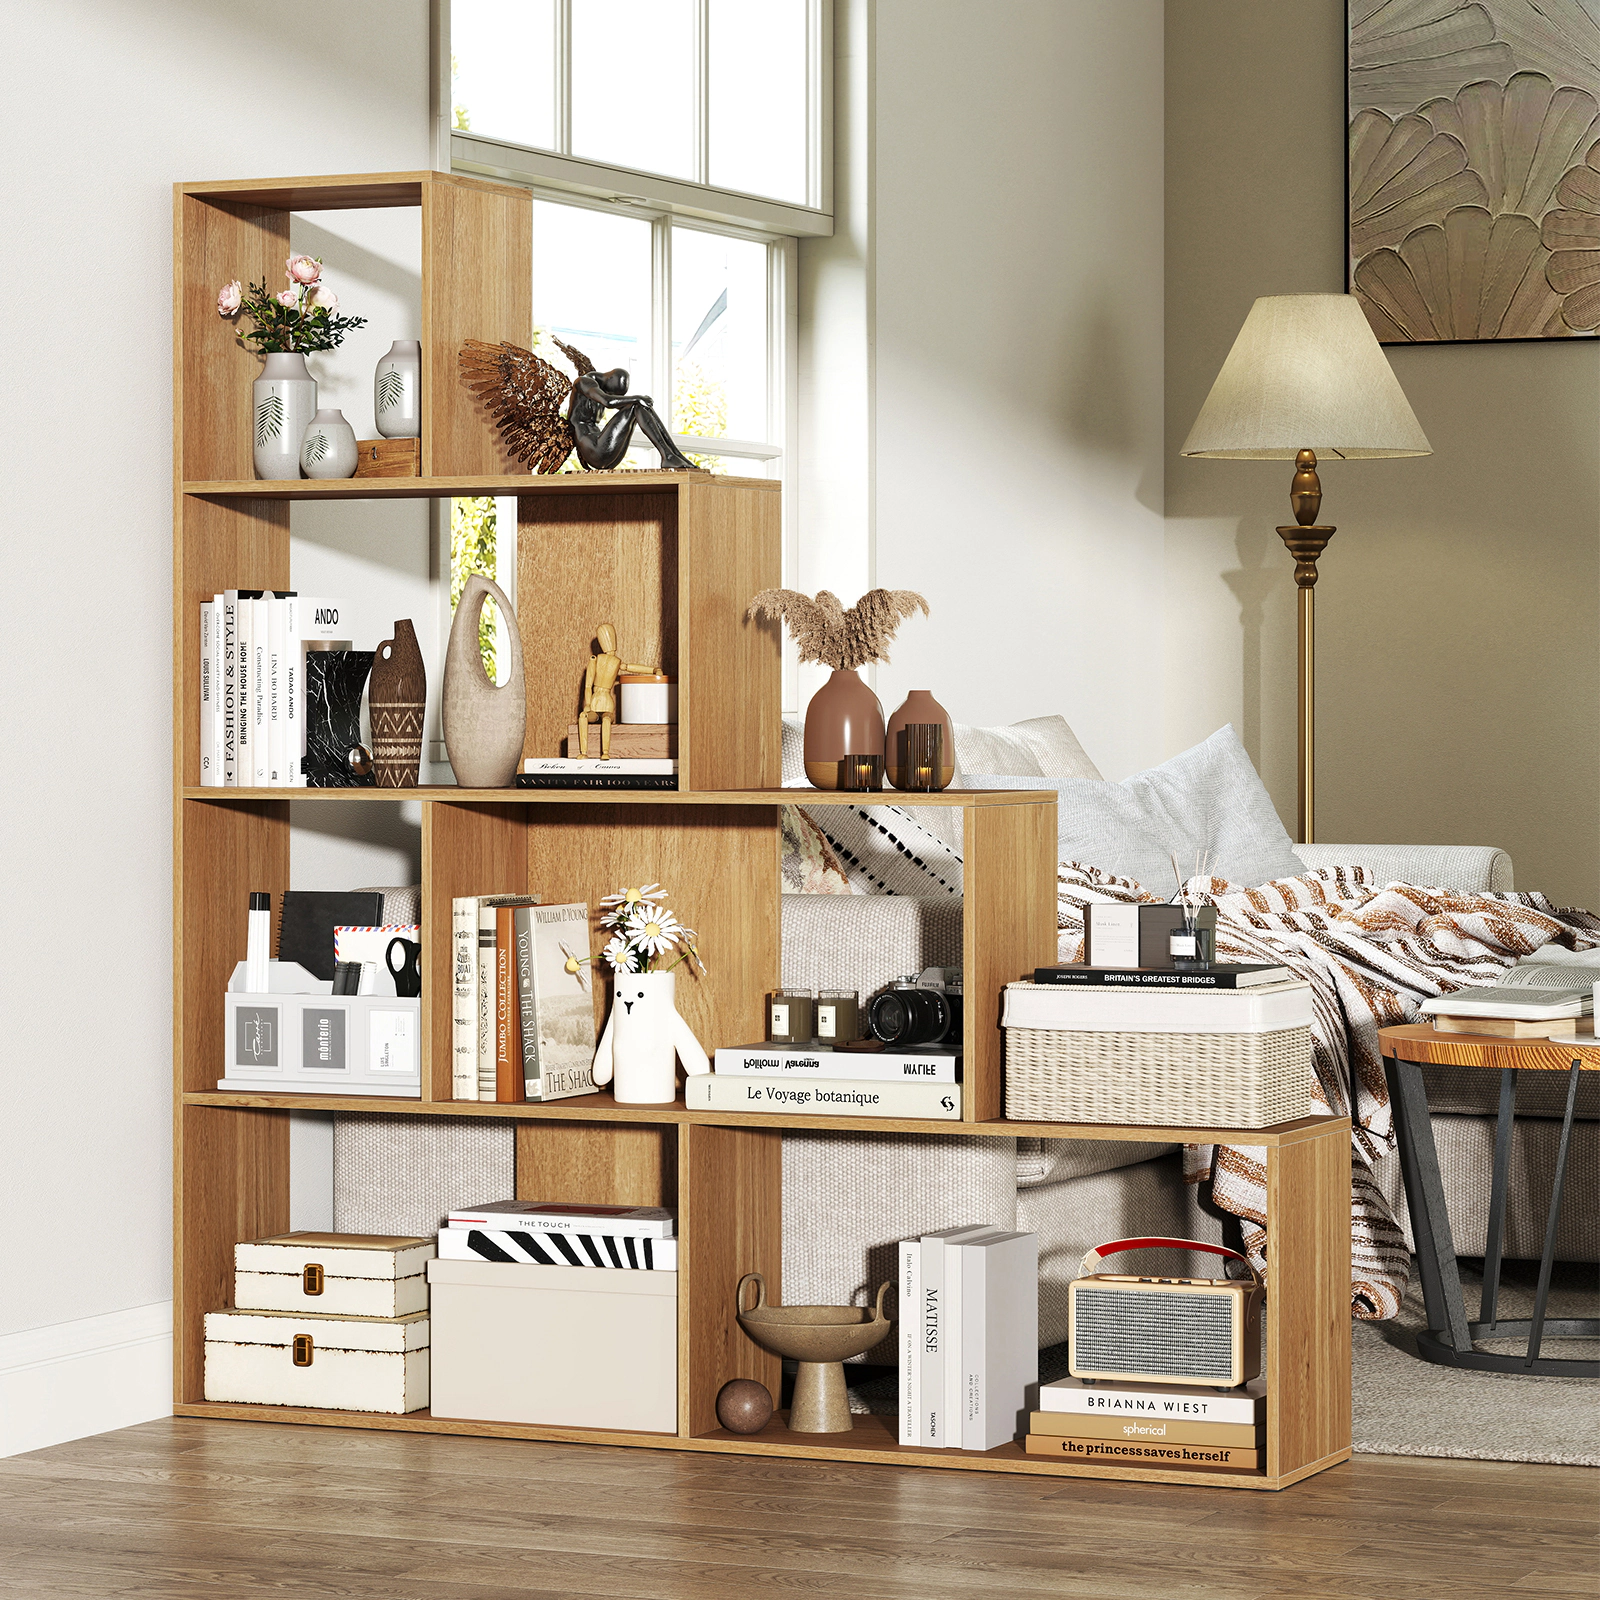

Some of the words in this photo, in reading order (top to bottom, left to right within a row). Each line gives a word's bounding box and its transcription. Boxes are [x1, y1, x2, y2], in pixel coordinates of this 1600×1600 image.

[314, 608, 339, 625] ANDO
[225, 605, 235, 660] STYLE
[225, 665, 235, 678] &
[271, 677, 277, 690] BO
[225, 682, 235, 762] FASHION
[520, 777, 570, 786] VANITY
[573, 778, 603, 786] FAIR
[635, 779, 676, 787] YEARS
[535, 910, 562, 924] WILLIAM
[567, 907, 588, 922] YOUNG
[517, 930, 530, 980] YOUNG
[498, 948, 507, 1021] COLLECTION
[1103, 974, 1141, 983] BRITAIN'S
[1142, 975, 1181, 984] GREATEST
[1181, 976, 1216, 984] BRIDGES
[521, 990, 534, 1016] THE
[498, 1024, 509, 1063] JUMBO
[522, 1020, 536, 1064] SHACK
[546, 1072, 566, 1093] THE
[568, 1069, 593, 1090] SHAC
[747, 1086, 762, 1100] Le
[765, 1087, 812, 1105] Voyage
[815, 1088, 880, 1107] botanique
[537, 1221, 571, 1229] TOUCH
[926, 1288, 938, 1353] MATISSE
[1087, 1397, 1156, 1411] BRIANNA
[1163, 1401, 1209, 1414] WIEST
[1122, 1422, 1167, 1436] spherical
[1061, 1441, 1084, 1453] the
[1086, 1442, 1143, 1457] princess
[1143, 1447, 1181, 1459] saves
[1182, 1448, 1230, 1462] herself
